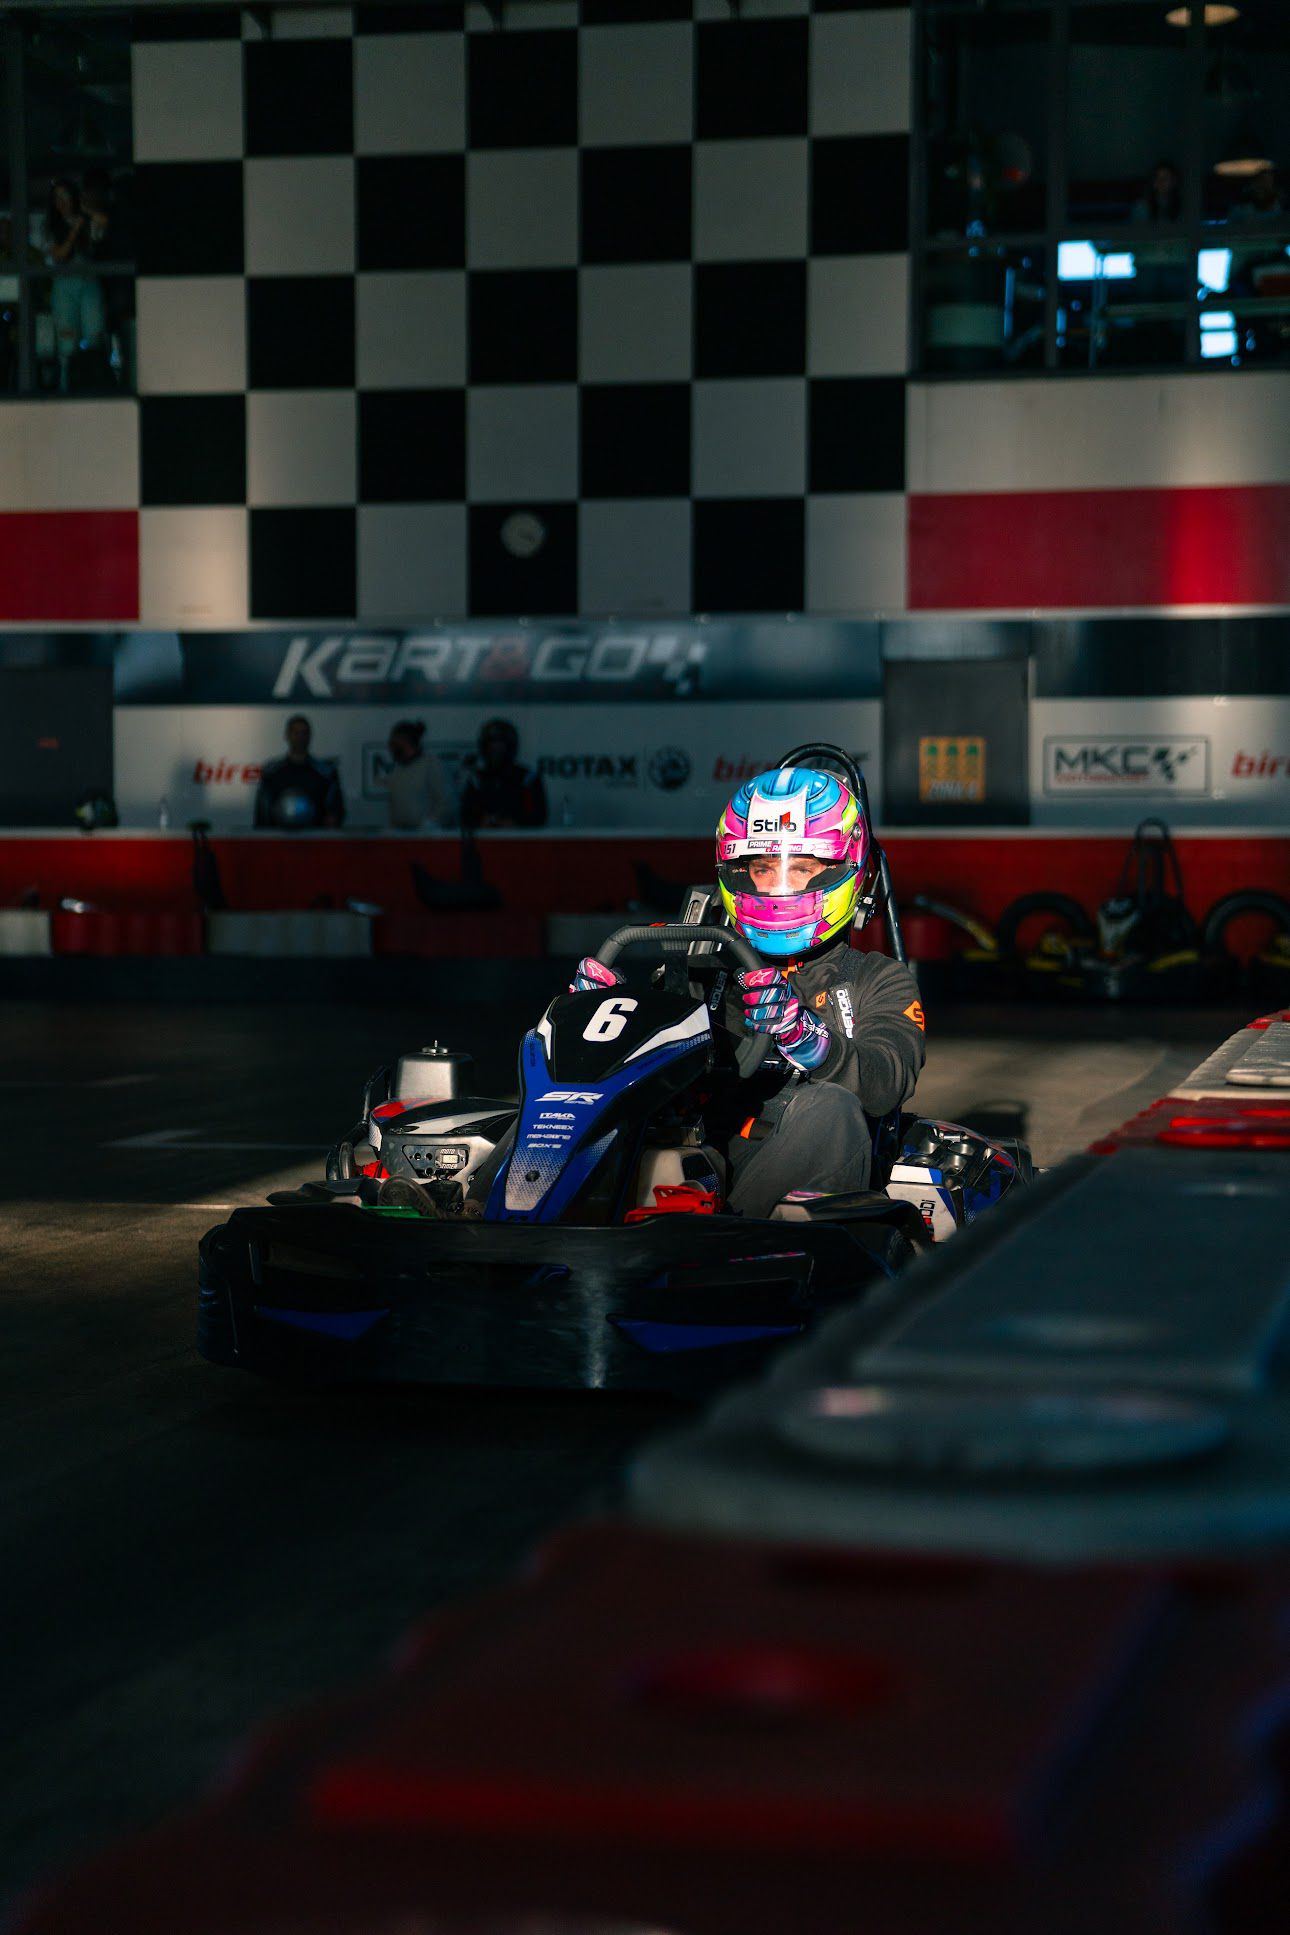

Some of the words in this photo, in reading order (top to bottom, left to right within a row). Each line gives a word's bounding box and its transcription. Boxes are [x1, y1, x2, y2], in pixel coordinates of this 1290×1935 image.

[538, 754, 635, 777] ROTAX
[1055, 746, 1150, 775] MKC
[753, 811, 797, 833] Stilo
[749, 840, 773, 848] PRIME
[771, 844, 802, 852] RAING
[582, 997, 638, 1042] 6
